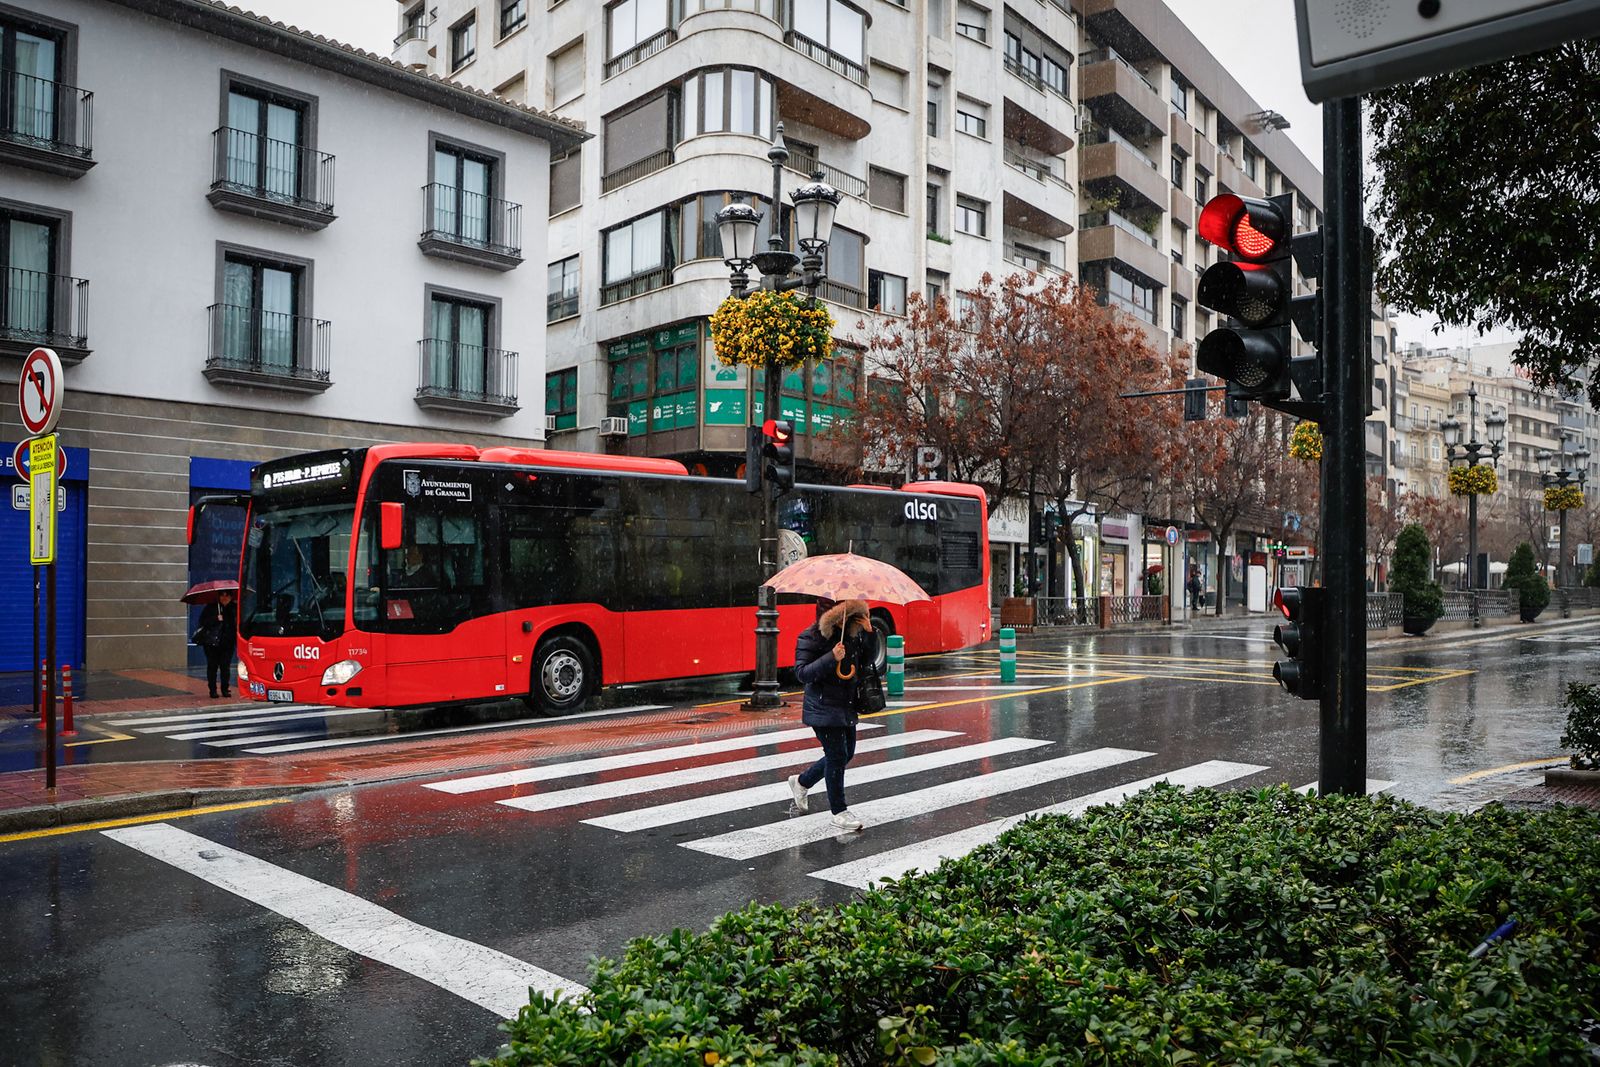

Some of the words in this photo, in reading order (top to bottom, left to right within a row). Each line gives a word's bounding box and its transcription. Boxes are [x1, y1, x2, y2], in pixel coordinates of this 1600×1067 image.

[435, 488, 466, 497] GRANADA
[904, 499, 937, 521] alsa
[294, 643, 320, 660] alsa
